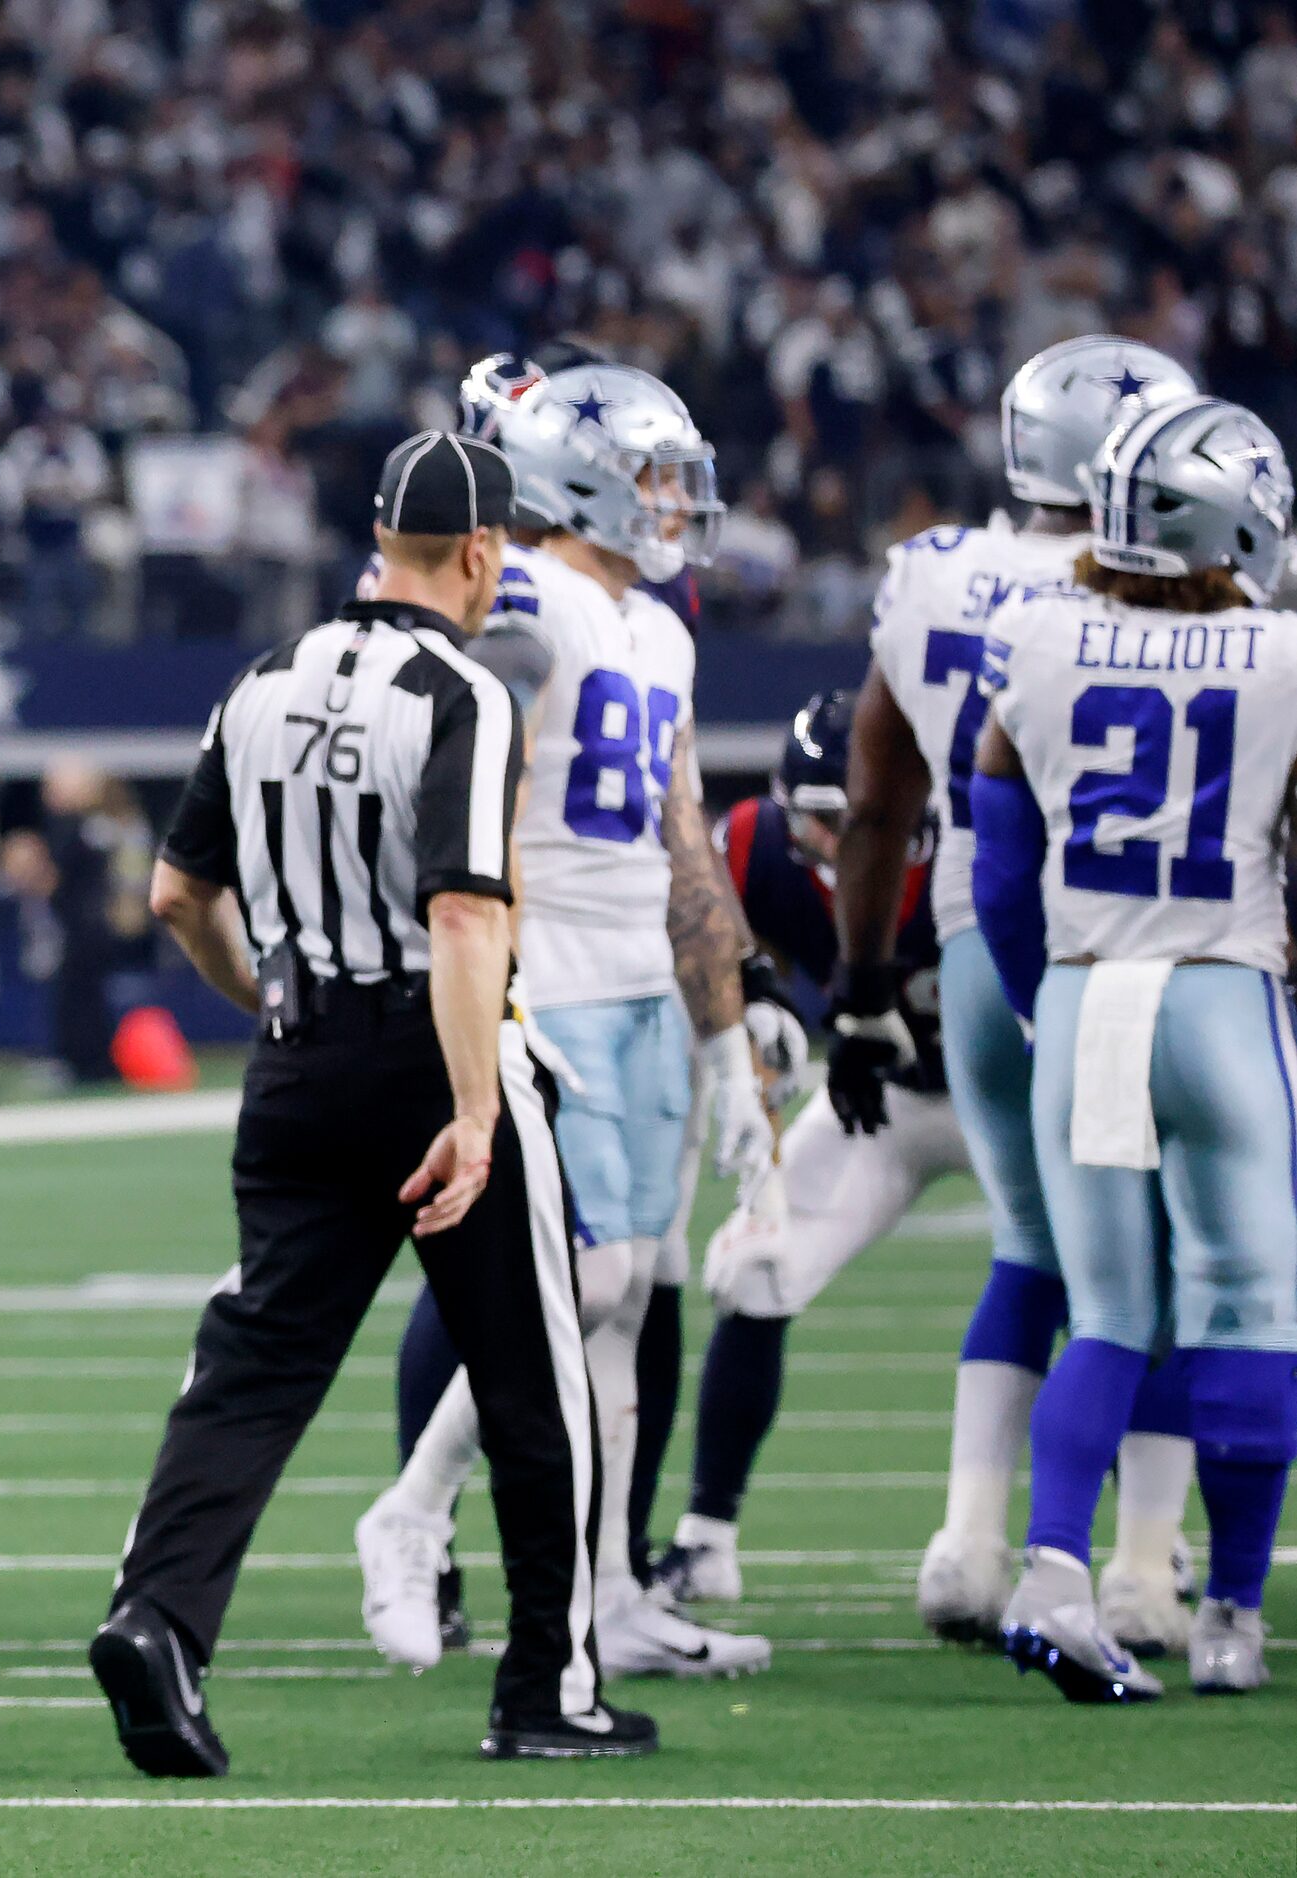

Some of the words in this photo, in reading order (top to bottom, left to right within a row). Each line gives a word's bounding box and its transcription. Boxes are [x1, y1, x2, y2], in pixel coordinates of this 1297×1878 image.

[1075, 621, 1265, 671] ELLIOTT
[281, 713, 366, 783] 76
[1063, 684, 1238, 902] 21
